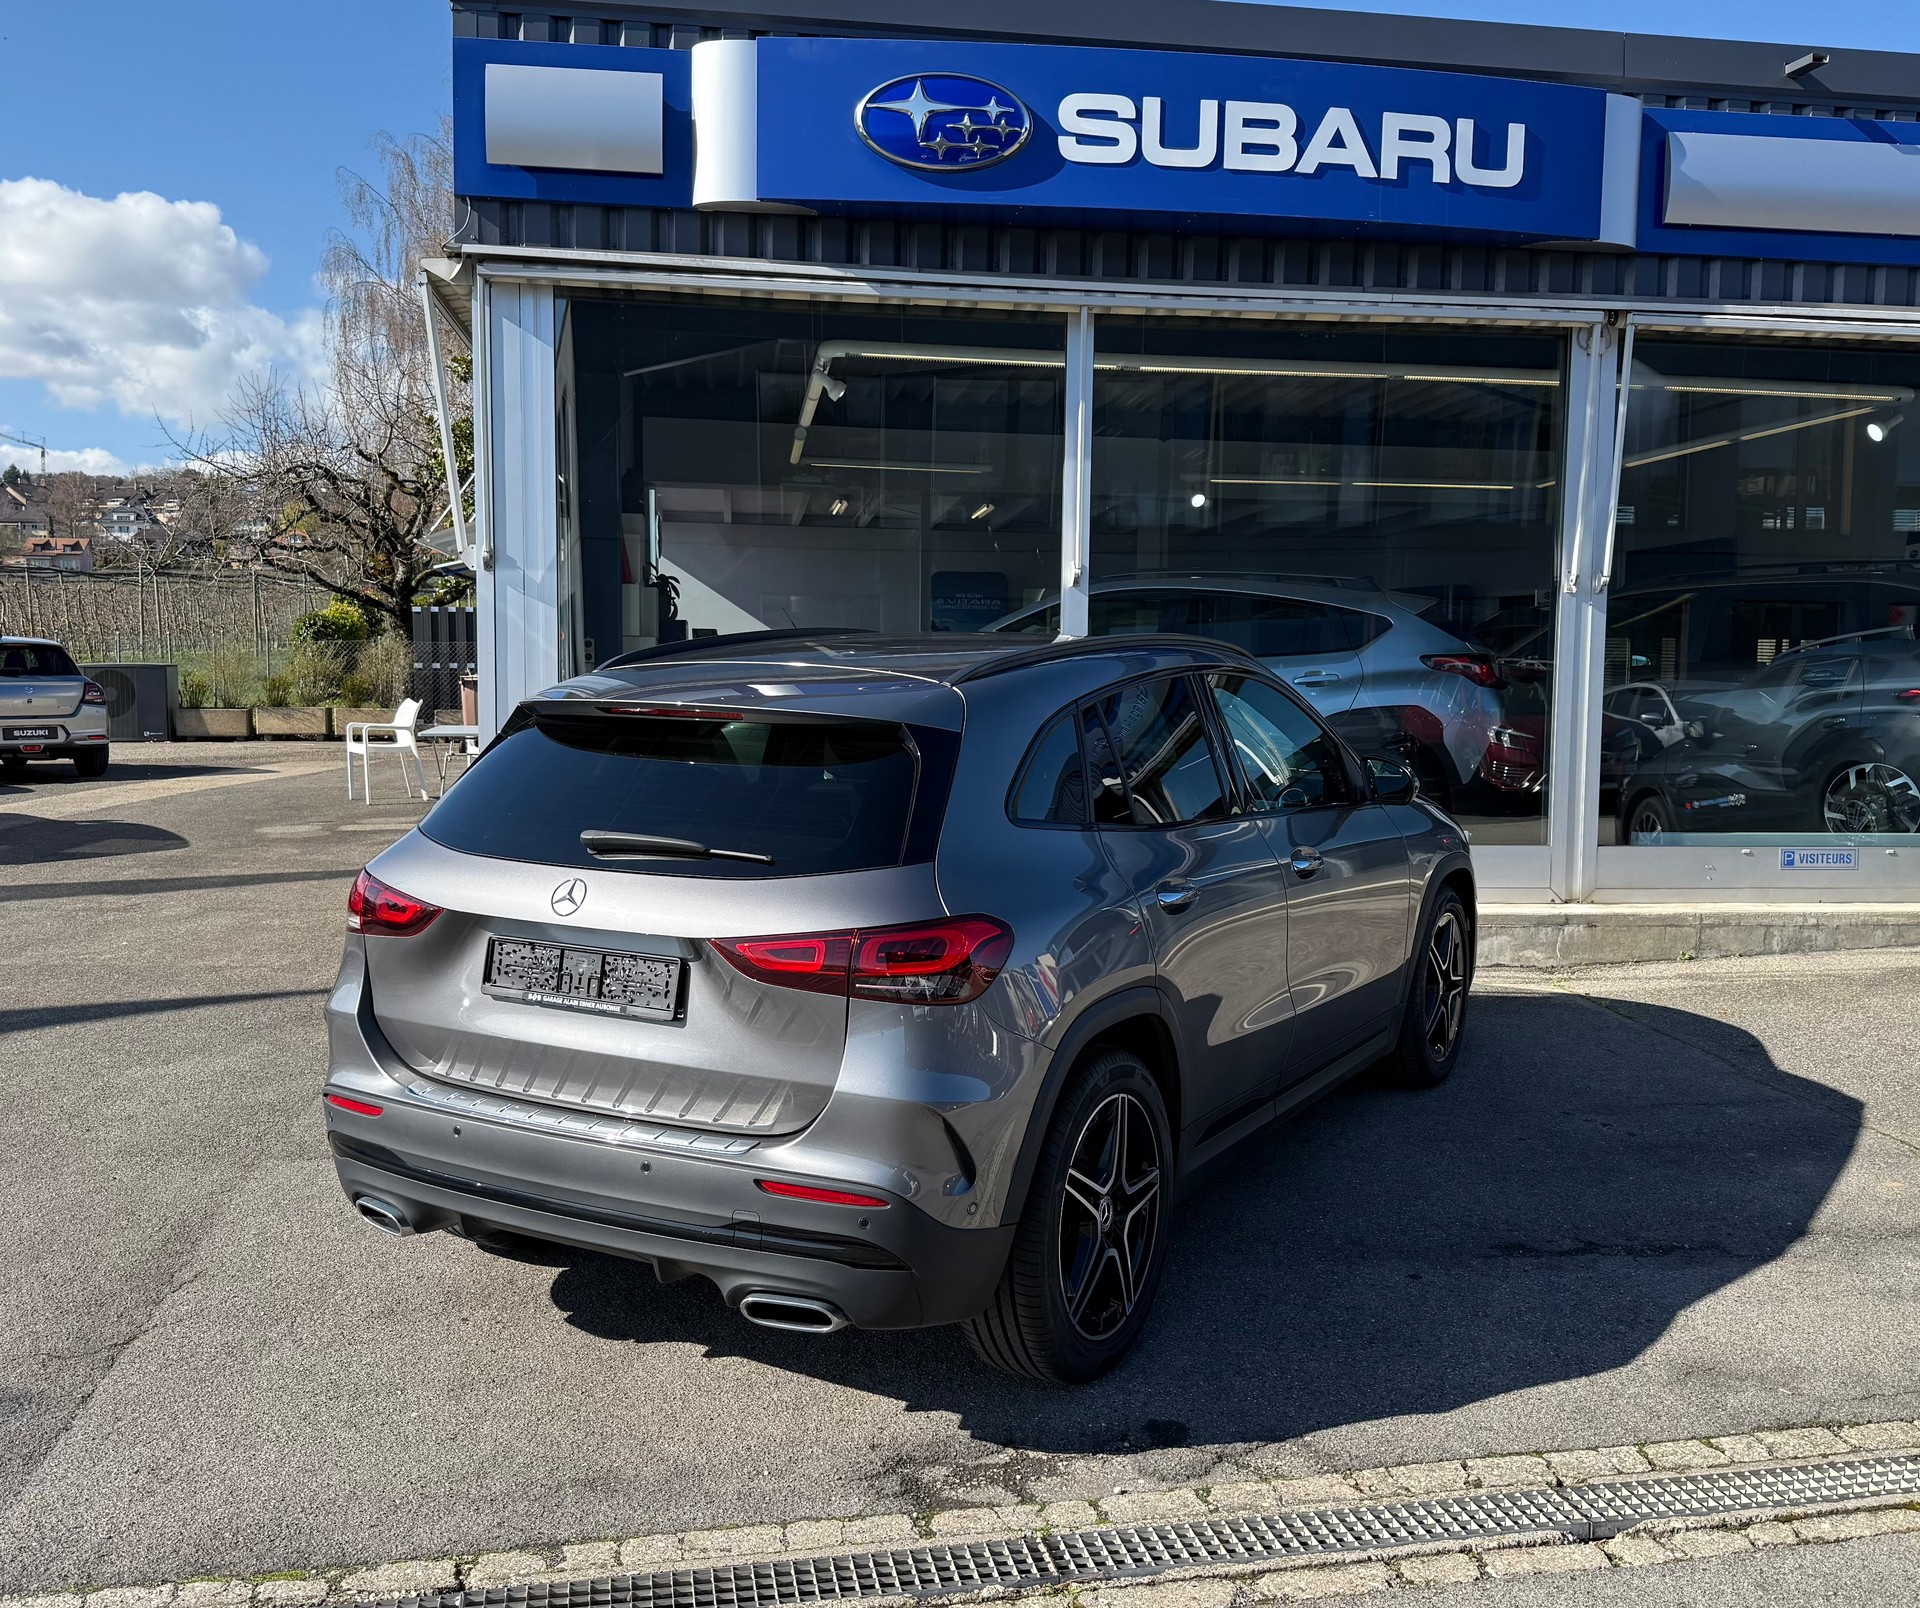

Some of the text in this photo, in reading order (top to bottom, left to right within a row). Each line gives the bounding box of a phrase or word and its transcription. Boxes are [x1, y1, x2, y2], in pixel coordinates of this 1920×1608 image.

[1057, 92, 1527, 188] SUBARU
[13, 729, 49, 737] SUZUKI
[1799, 853, 1852, 864] VISITEURS
[543, 995, 563, 1004] GARAGE
